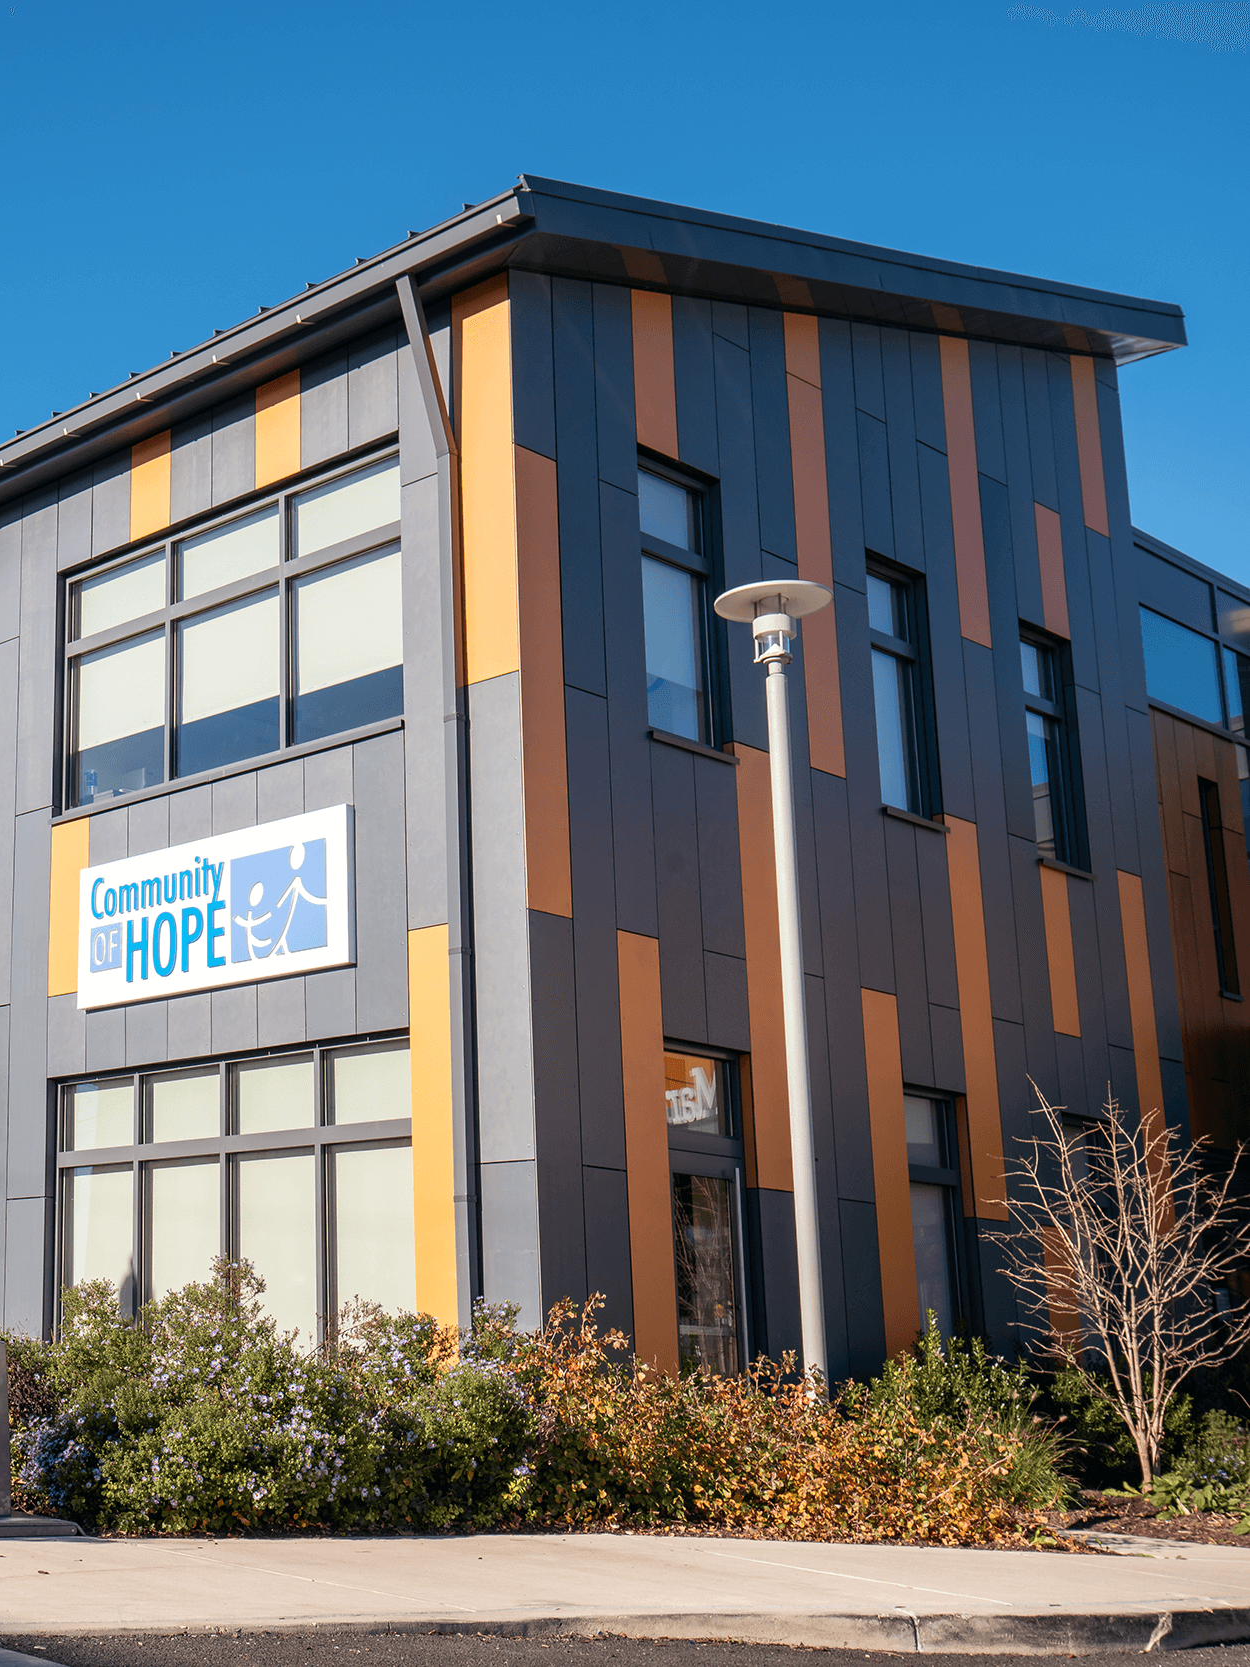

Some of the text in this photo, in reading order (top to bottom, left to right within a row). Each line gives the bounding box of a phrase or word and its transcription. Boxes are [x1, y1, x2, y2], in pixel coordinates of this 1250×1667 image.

[91, 856, 225, 919] Community
[93, 900, 226, 983] OF HOPE
